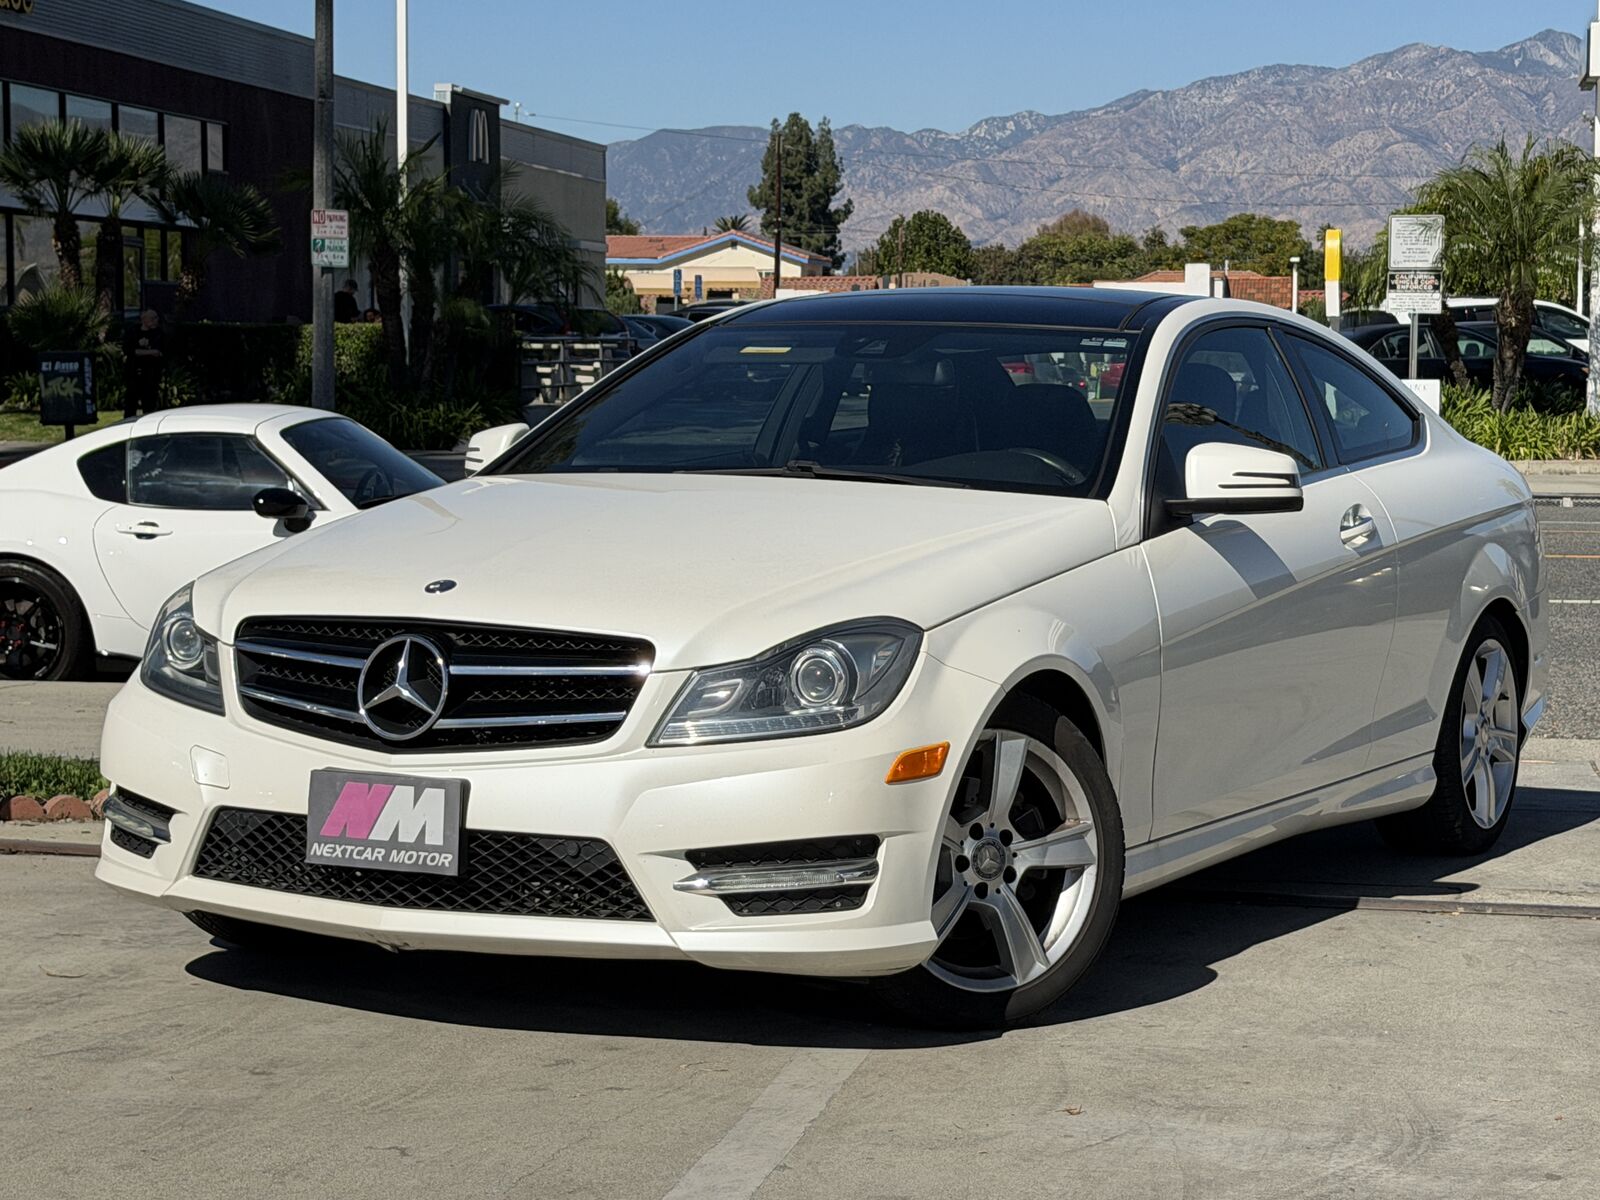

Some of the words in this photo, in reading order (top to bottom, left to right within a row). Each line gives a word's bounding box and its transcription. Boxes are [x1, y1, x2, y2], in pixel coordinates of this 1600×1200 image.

[313, 210, 325, 224] NO
[327, 213, 346, 222] PARKING
[320, 781, 446, 846] NM
[310, 842, 386, 862] NEXTCAR
[389, 849, 453, 868] MOTOR
